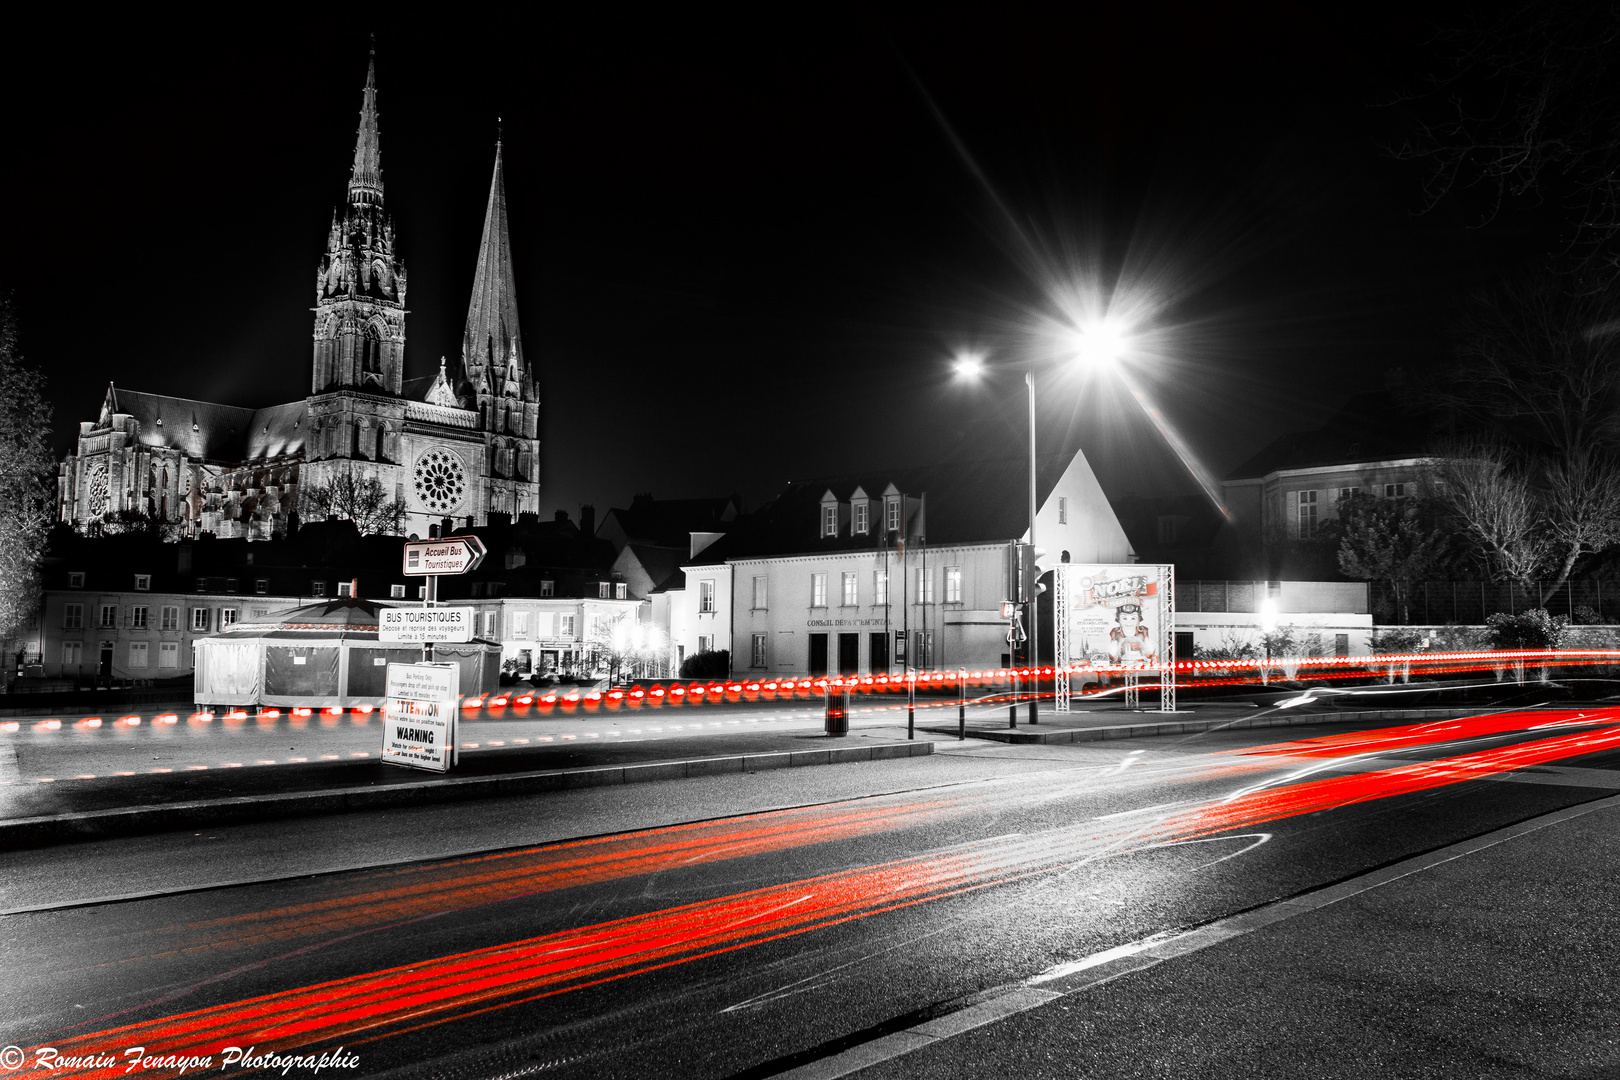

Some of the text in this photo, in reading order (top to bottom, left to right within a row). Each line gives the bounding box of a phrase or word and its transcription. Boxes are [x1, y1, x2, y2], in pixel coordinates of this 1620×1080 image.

[424, 546, 462, 556] Accueil Bus
[425, 560, 464, 570] Touristiques
[386, 612, 462, 622] BUS TOURISTIQUES
[834, 618, 892, 626] DEPAREMNTL
[395, 700, 440, 717] TTENION
[396, 726, 434, 744] WARNING
